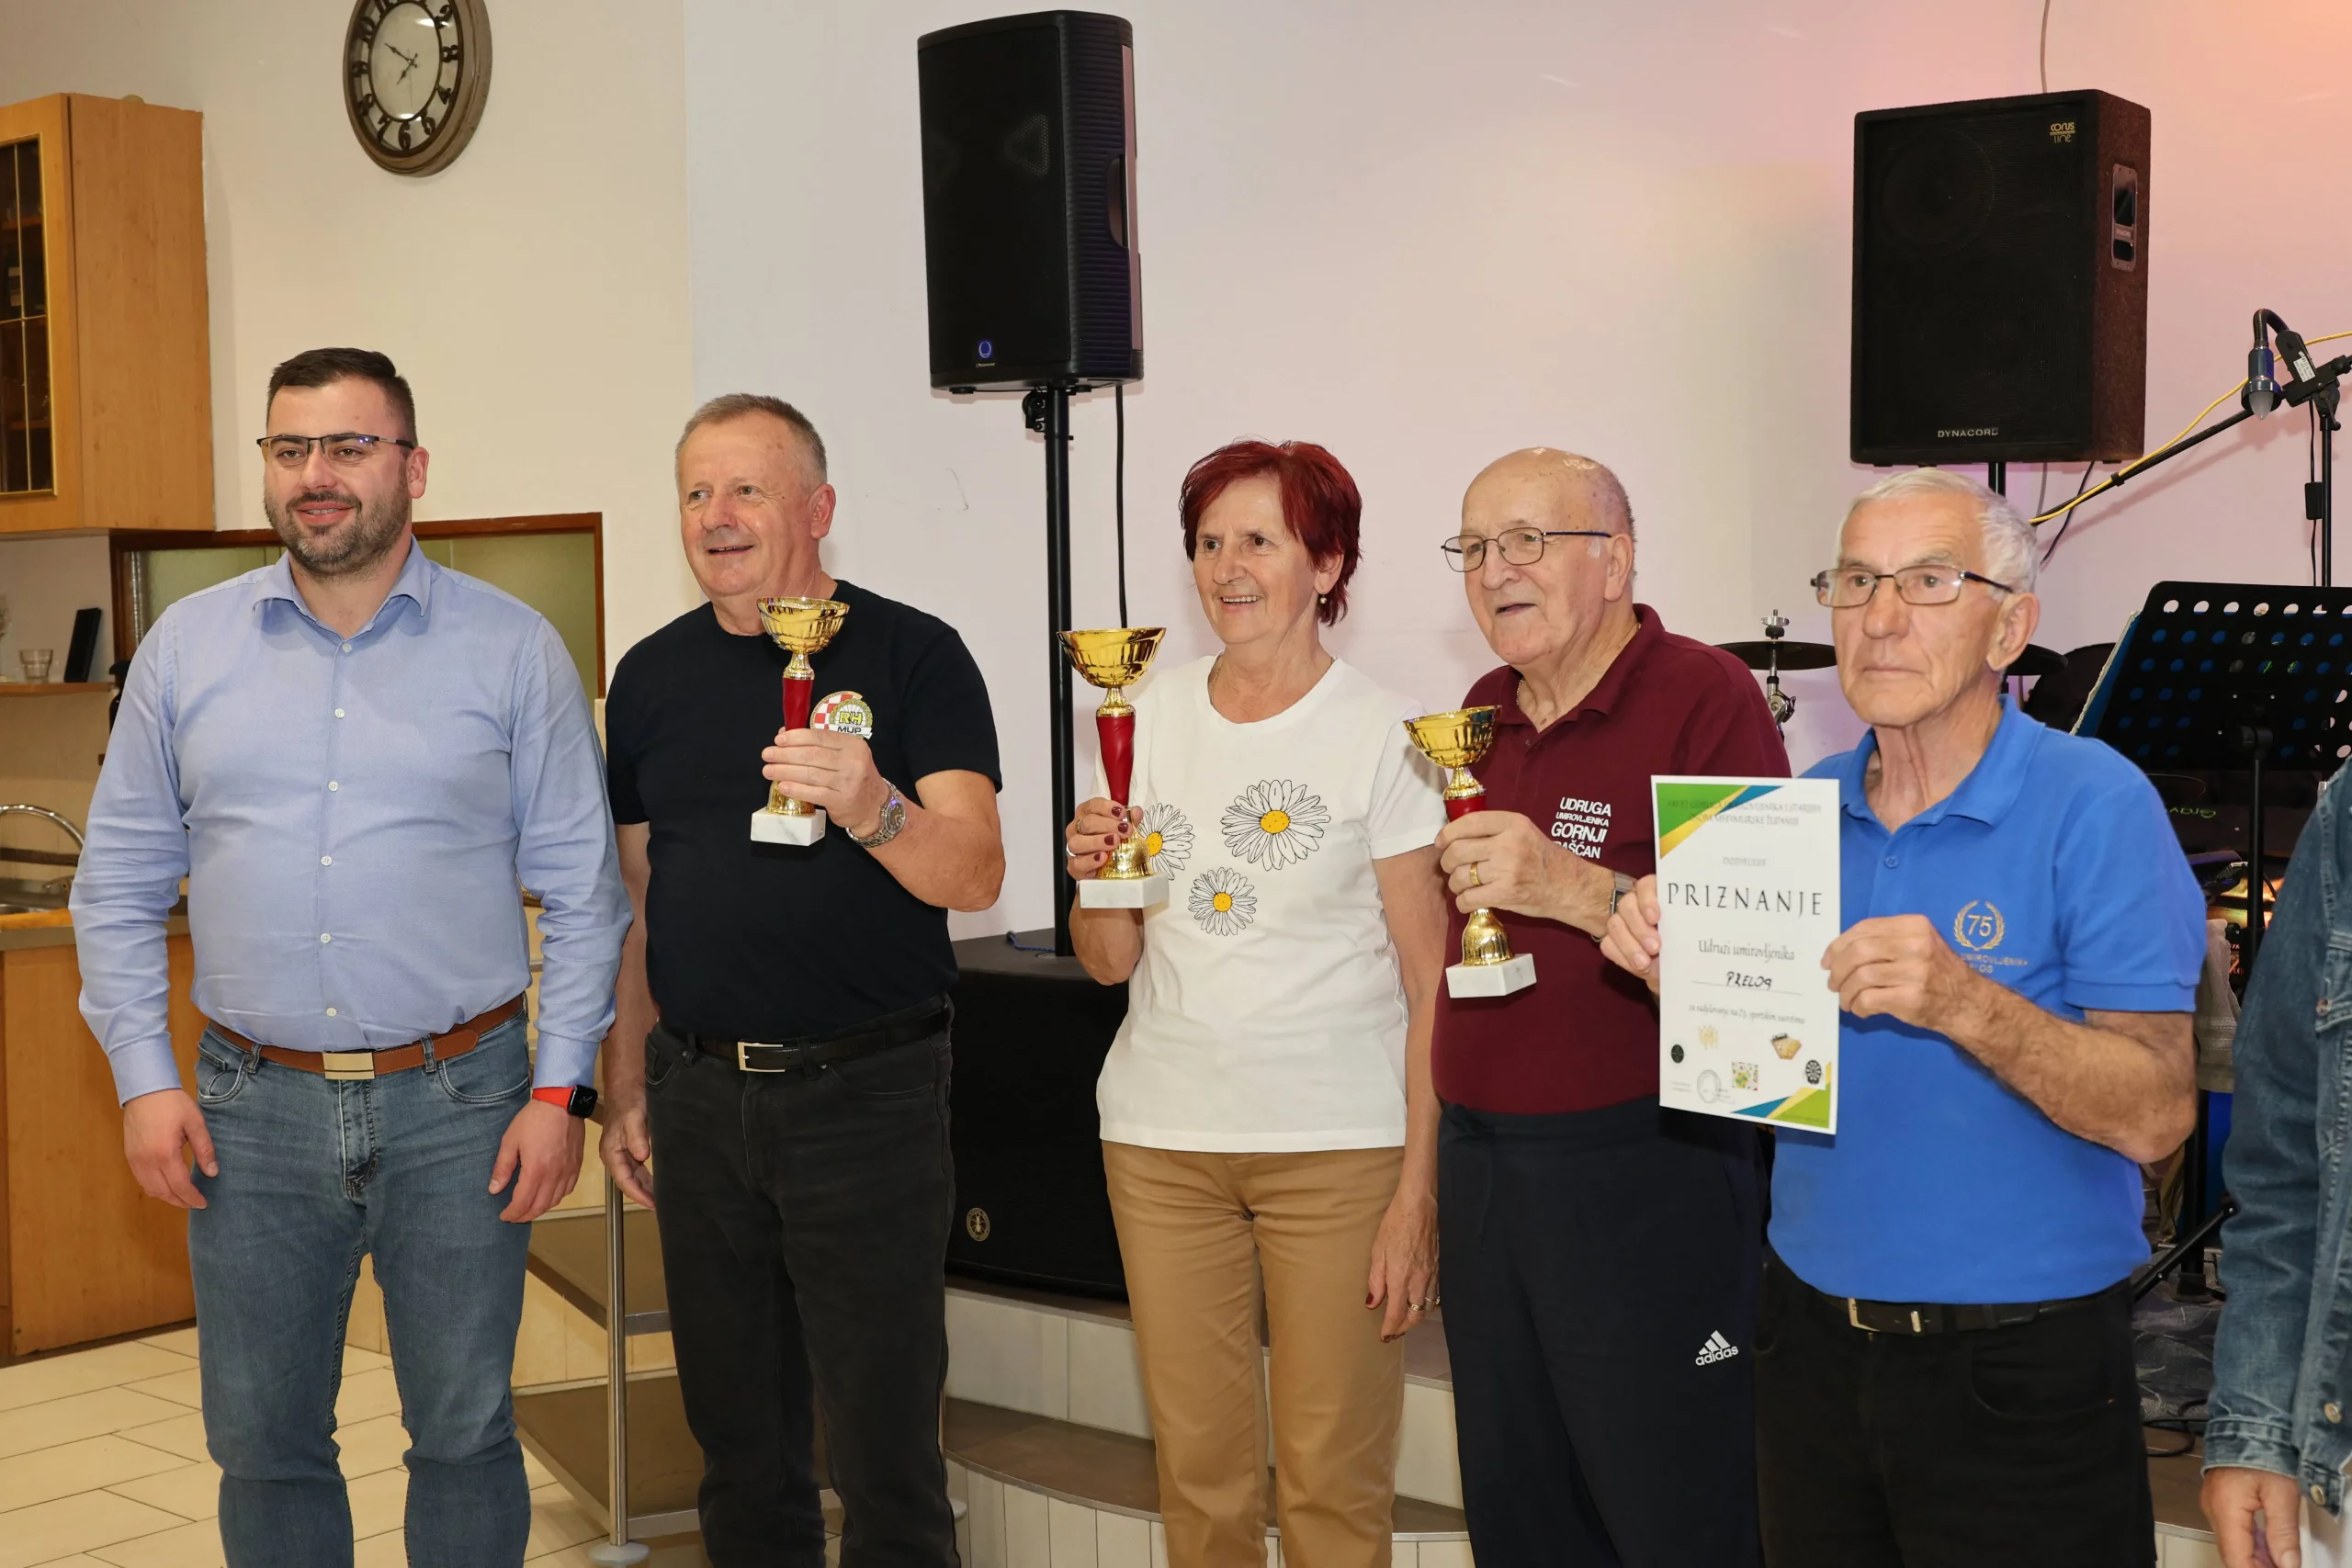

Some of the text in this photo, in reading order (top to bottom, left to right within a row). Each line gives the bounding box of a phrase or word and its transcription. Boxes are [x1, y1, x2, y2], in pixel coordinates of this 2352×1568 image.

[1938, 427, 1999, 438] DYNACORD
[839, 711, 863, 726] RH
[837, 726, 862, 734] MUP
[1559, 796, 1611, 817] UDRUGA
[2165, 807, 2217, 819] Grav
[1555, 811, 1610, 827] UMIROVLJENIKA
[1551, 821, 1607, 843] GORNJI
[1668, 883, 1823, 918] PRIZNANJE
[1967, 915, 1993, 937] 75
[1695, 1346, 1739, 1366] adidas
